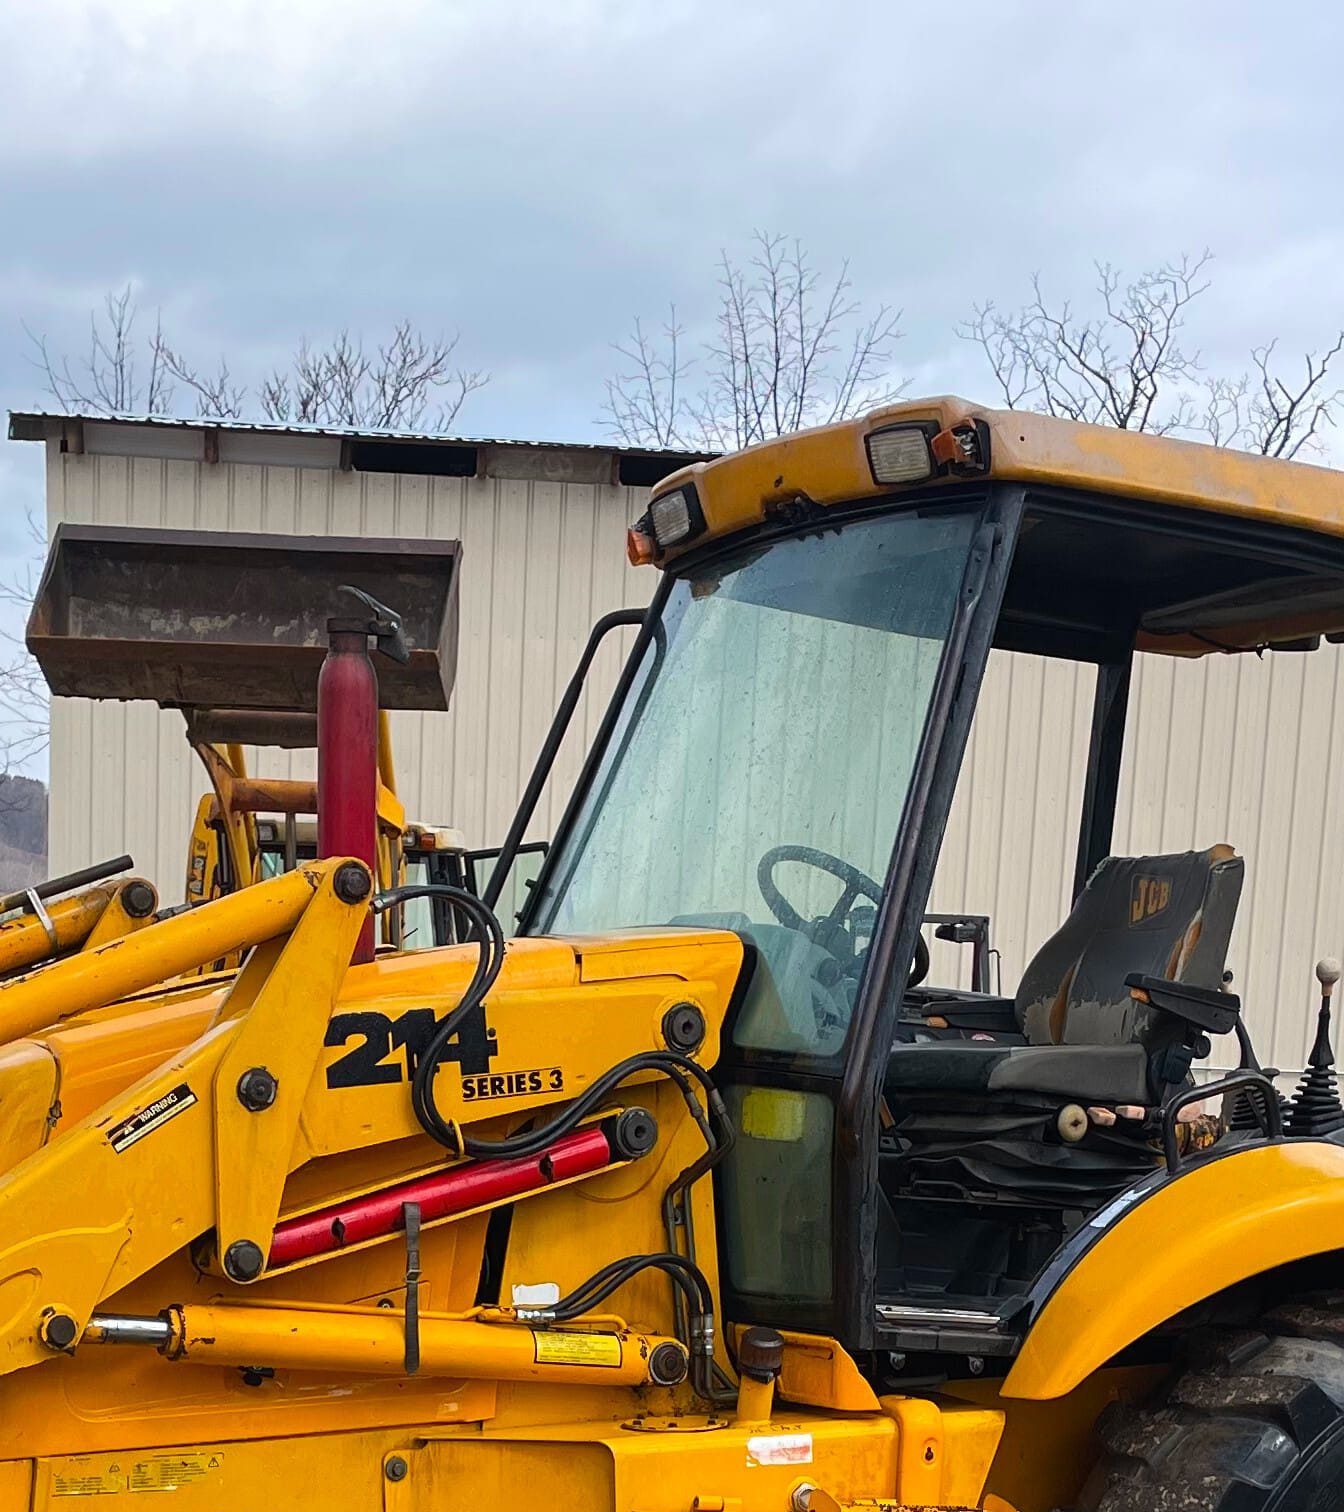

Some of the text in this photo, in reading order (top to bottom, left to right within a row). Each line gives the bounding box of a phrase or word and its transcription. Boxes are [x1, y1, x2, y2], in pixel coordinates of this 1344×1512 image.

[1132, 880, 1169, 921] JCB
[324, 1003, 498, 1089] 214
[462, 1070, 564, 1099] SERIES 3
[138, 1093, 178, 1122] WARNING
